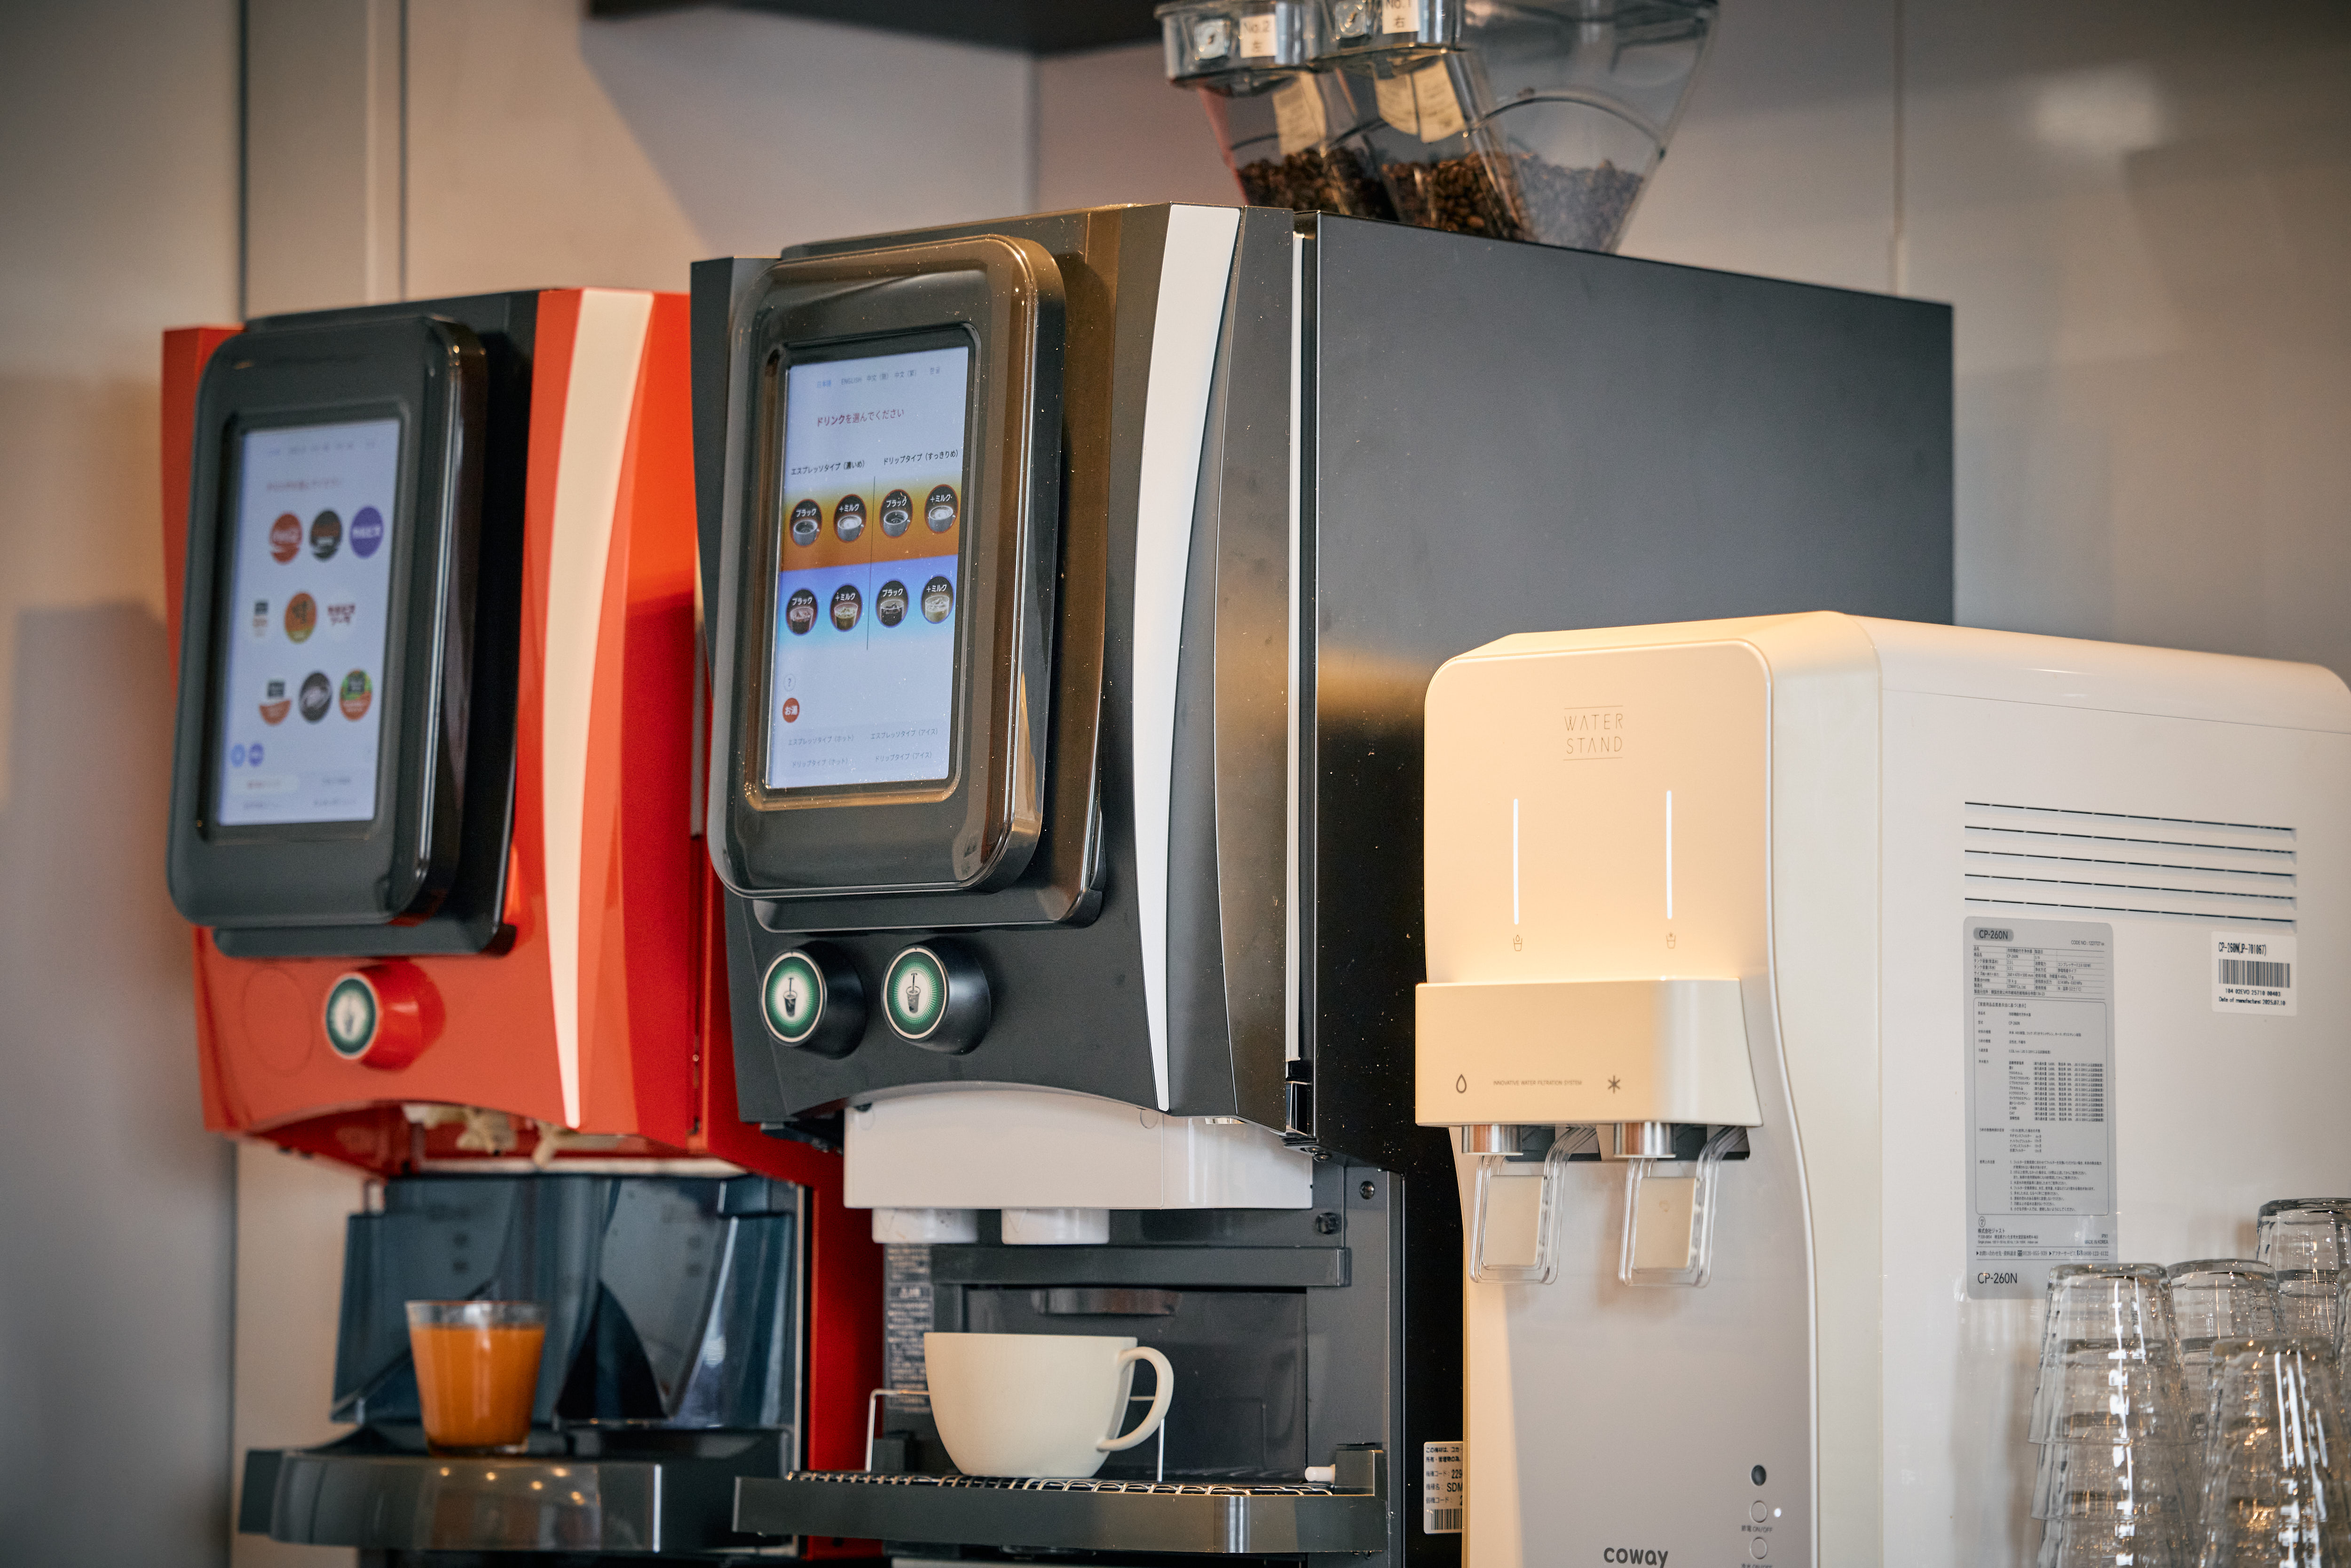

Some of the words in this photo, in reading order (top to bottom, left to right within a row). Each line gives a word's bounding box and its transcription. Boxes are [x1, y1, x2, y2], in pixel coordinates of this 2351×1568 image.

[817, 409, 904, 427] ドリンクを選んでください
[886, 498, 907, 508] ブラック
[796, 508, 816, 518] ブラック
[882, 588, 903, 597] ブラック
[792, 597, 813, 606] ブラック
[1564, 713, 1623, 731] WATER
[1566, 736, 1622, 754] STAND
[1979, 930, 2008, 939] CP-260N
[1978, 1273, 2017, 1284] CP-260N
[1603, 1547, 1668, 1568] coway
